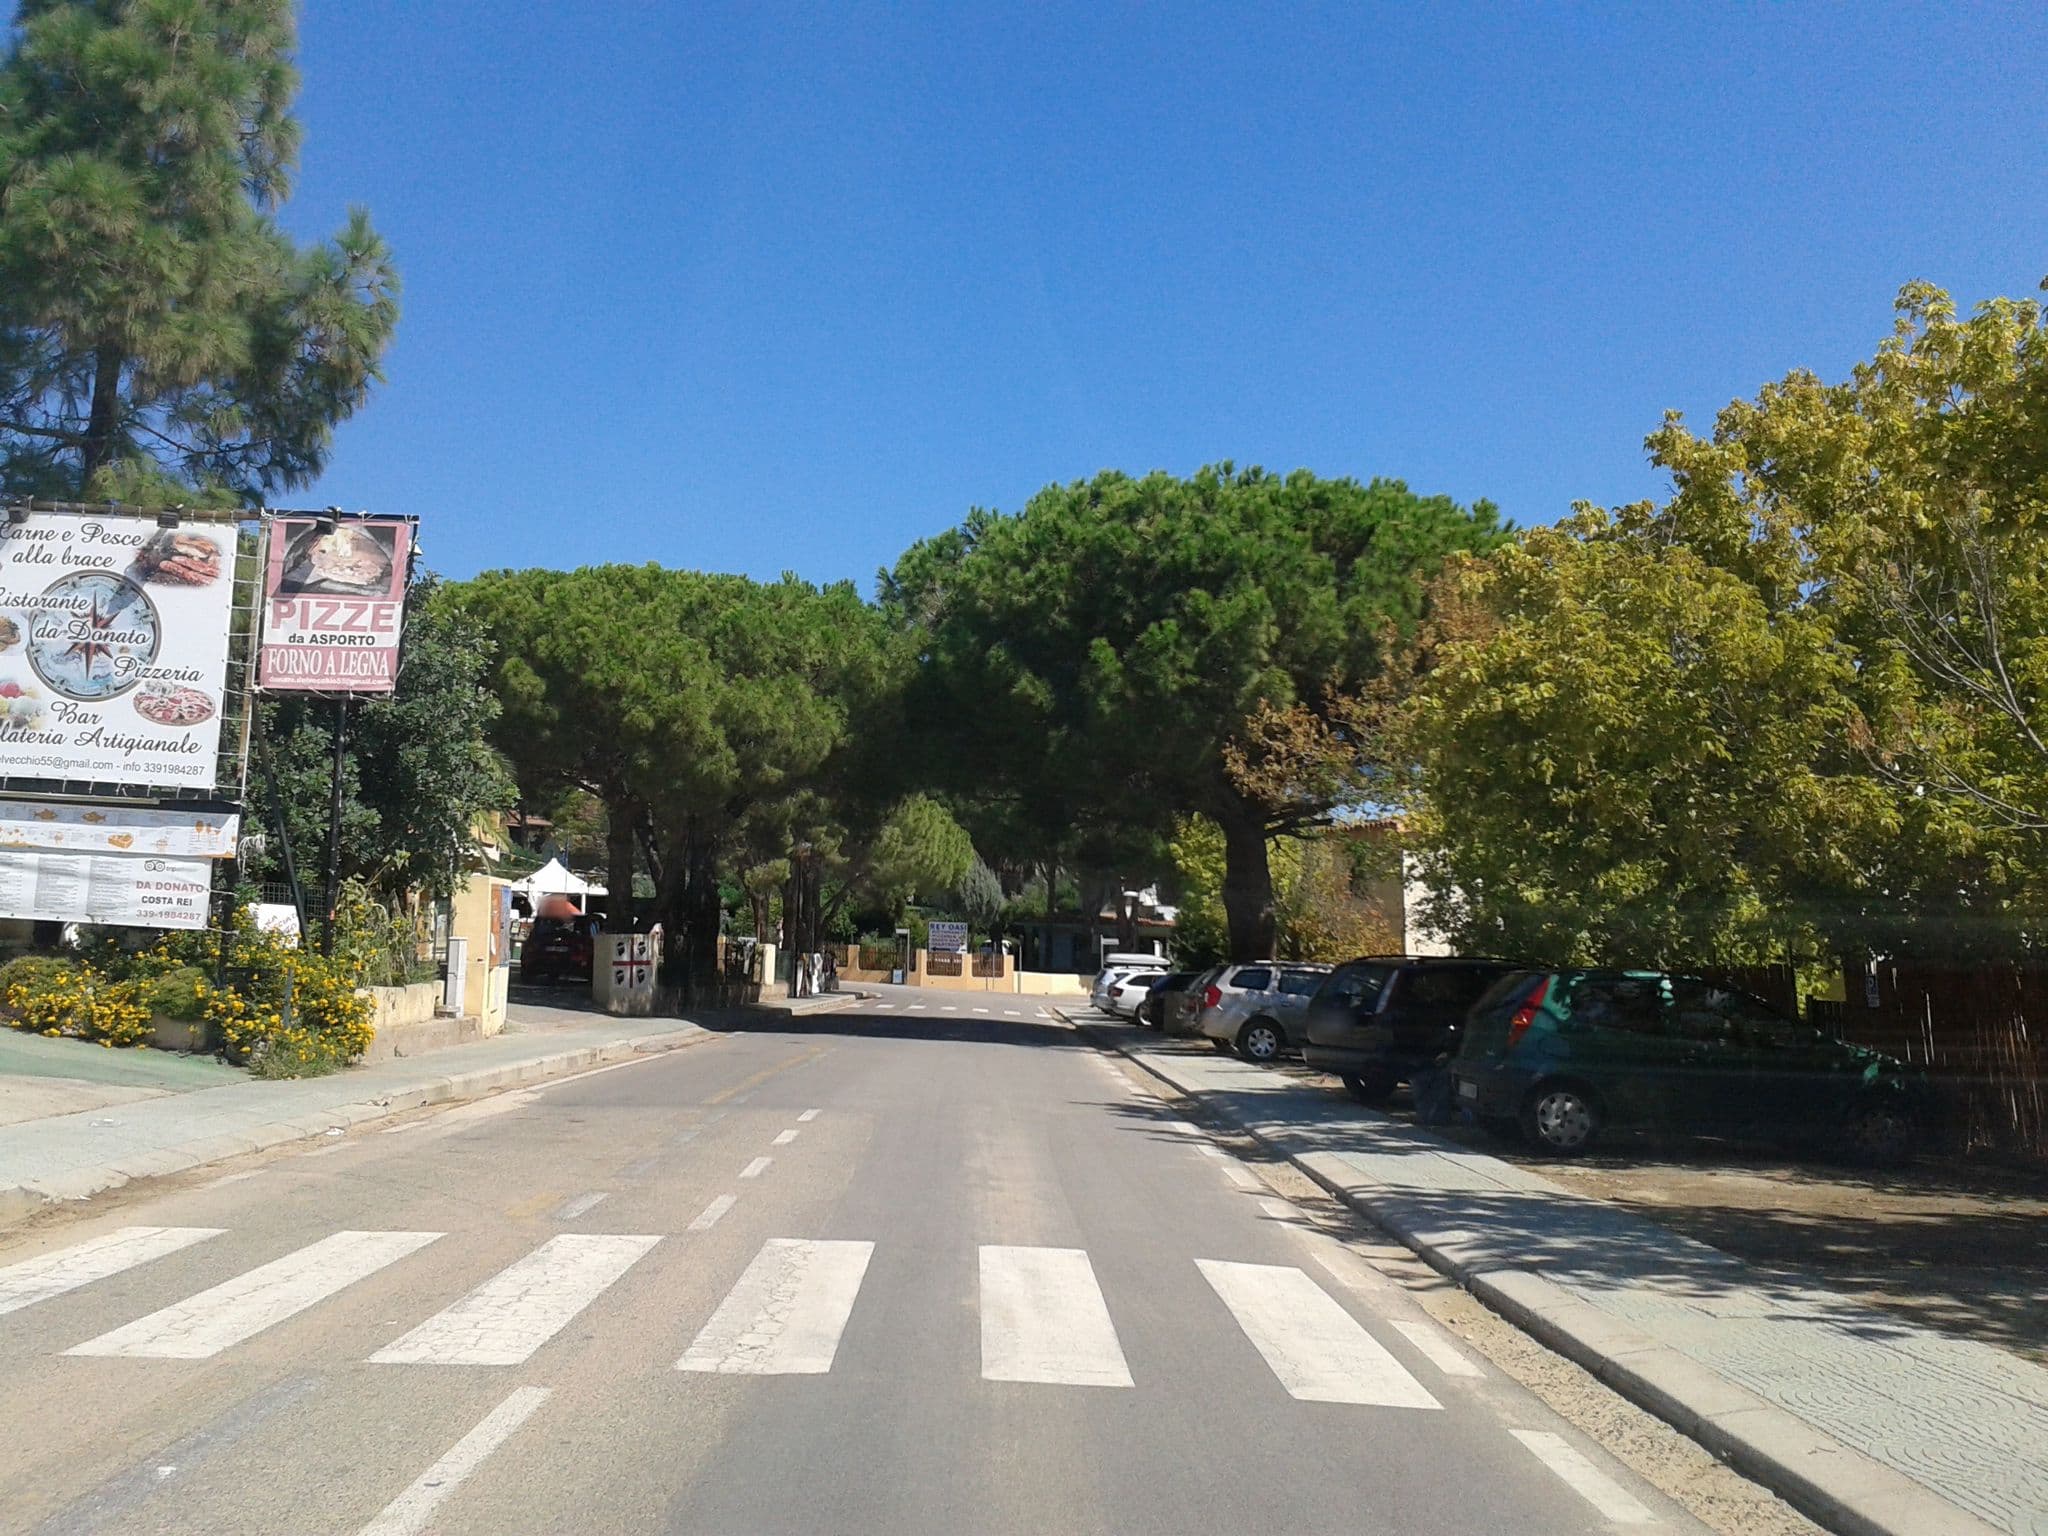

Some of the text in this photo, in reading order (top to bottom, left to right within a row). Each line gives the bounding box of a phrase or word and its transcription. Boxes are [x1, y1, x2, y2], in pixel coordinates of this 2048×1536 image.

[62, 530, 75, 542] e
[80, 522, 145, 546] Pesce
[12, 543, 116, 568] alla brace
[271, 599, 396, 632] PIZZE
[35, 619, 151, 645] da Donato
[288, 633, 376, 646] da ASPORTO
[113, 655, 204, 681] Pizzeria
[266, 648, 390, 676] FORNO A LEGNA
[51, 700, 103, 725] Bar
[74, 726, 203, 757] Artigianale
[123, 761, 141, 773] info
[144, 762, 205, 776] 3391984287
[136, 880, 204, 893] DA DONATO
[141, 895, 193, 906] COSTA REI
